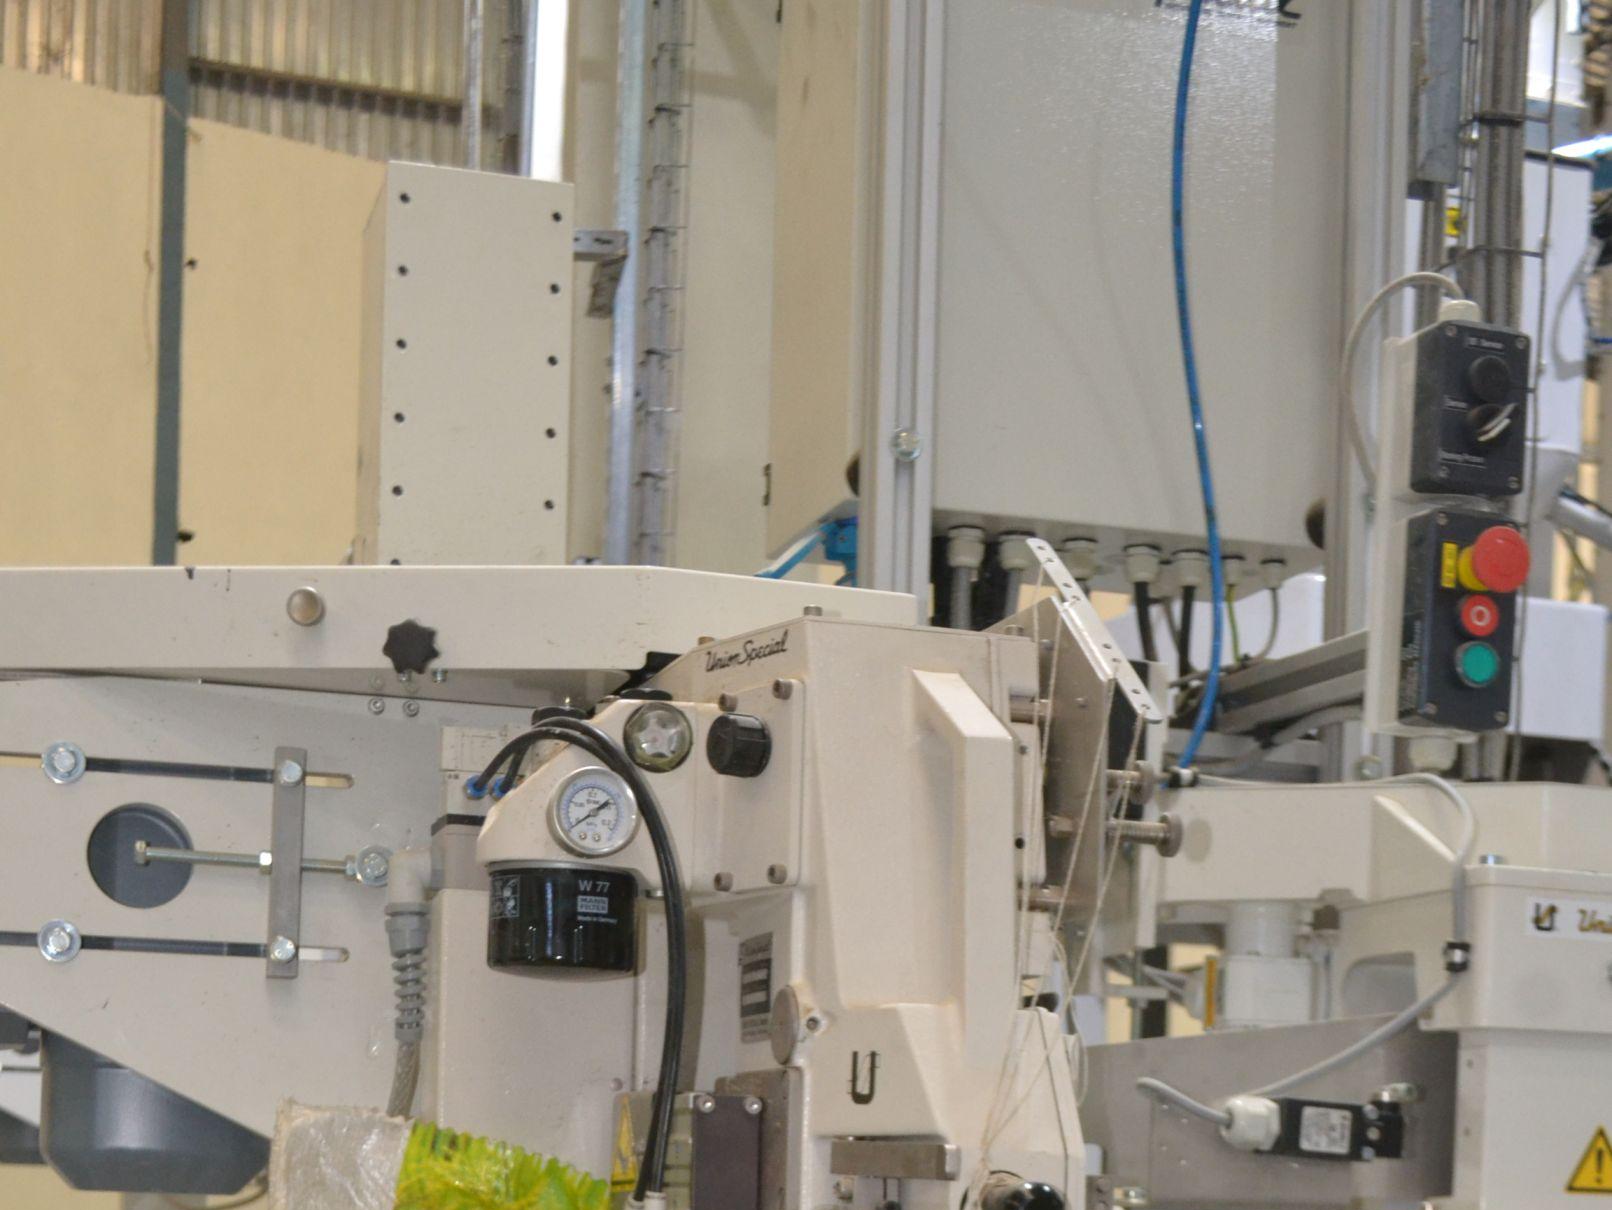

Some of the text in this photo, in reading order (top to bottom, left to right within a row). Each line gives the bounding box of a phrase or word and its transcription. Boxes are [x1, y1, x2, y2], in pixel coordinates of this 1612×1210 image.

[706, 628, 788, 672] Union Special
[578, 879, 611, 893] W 77
